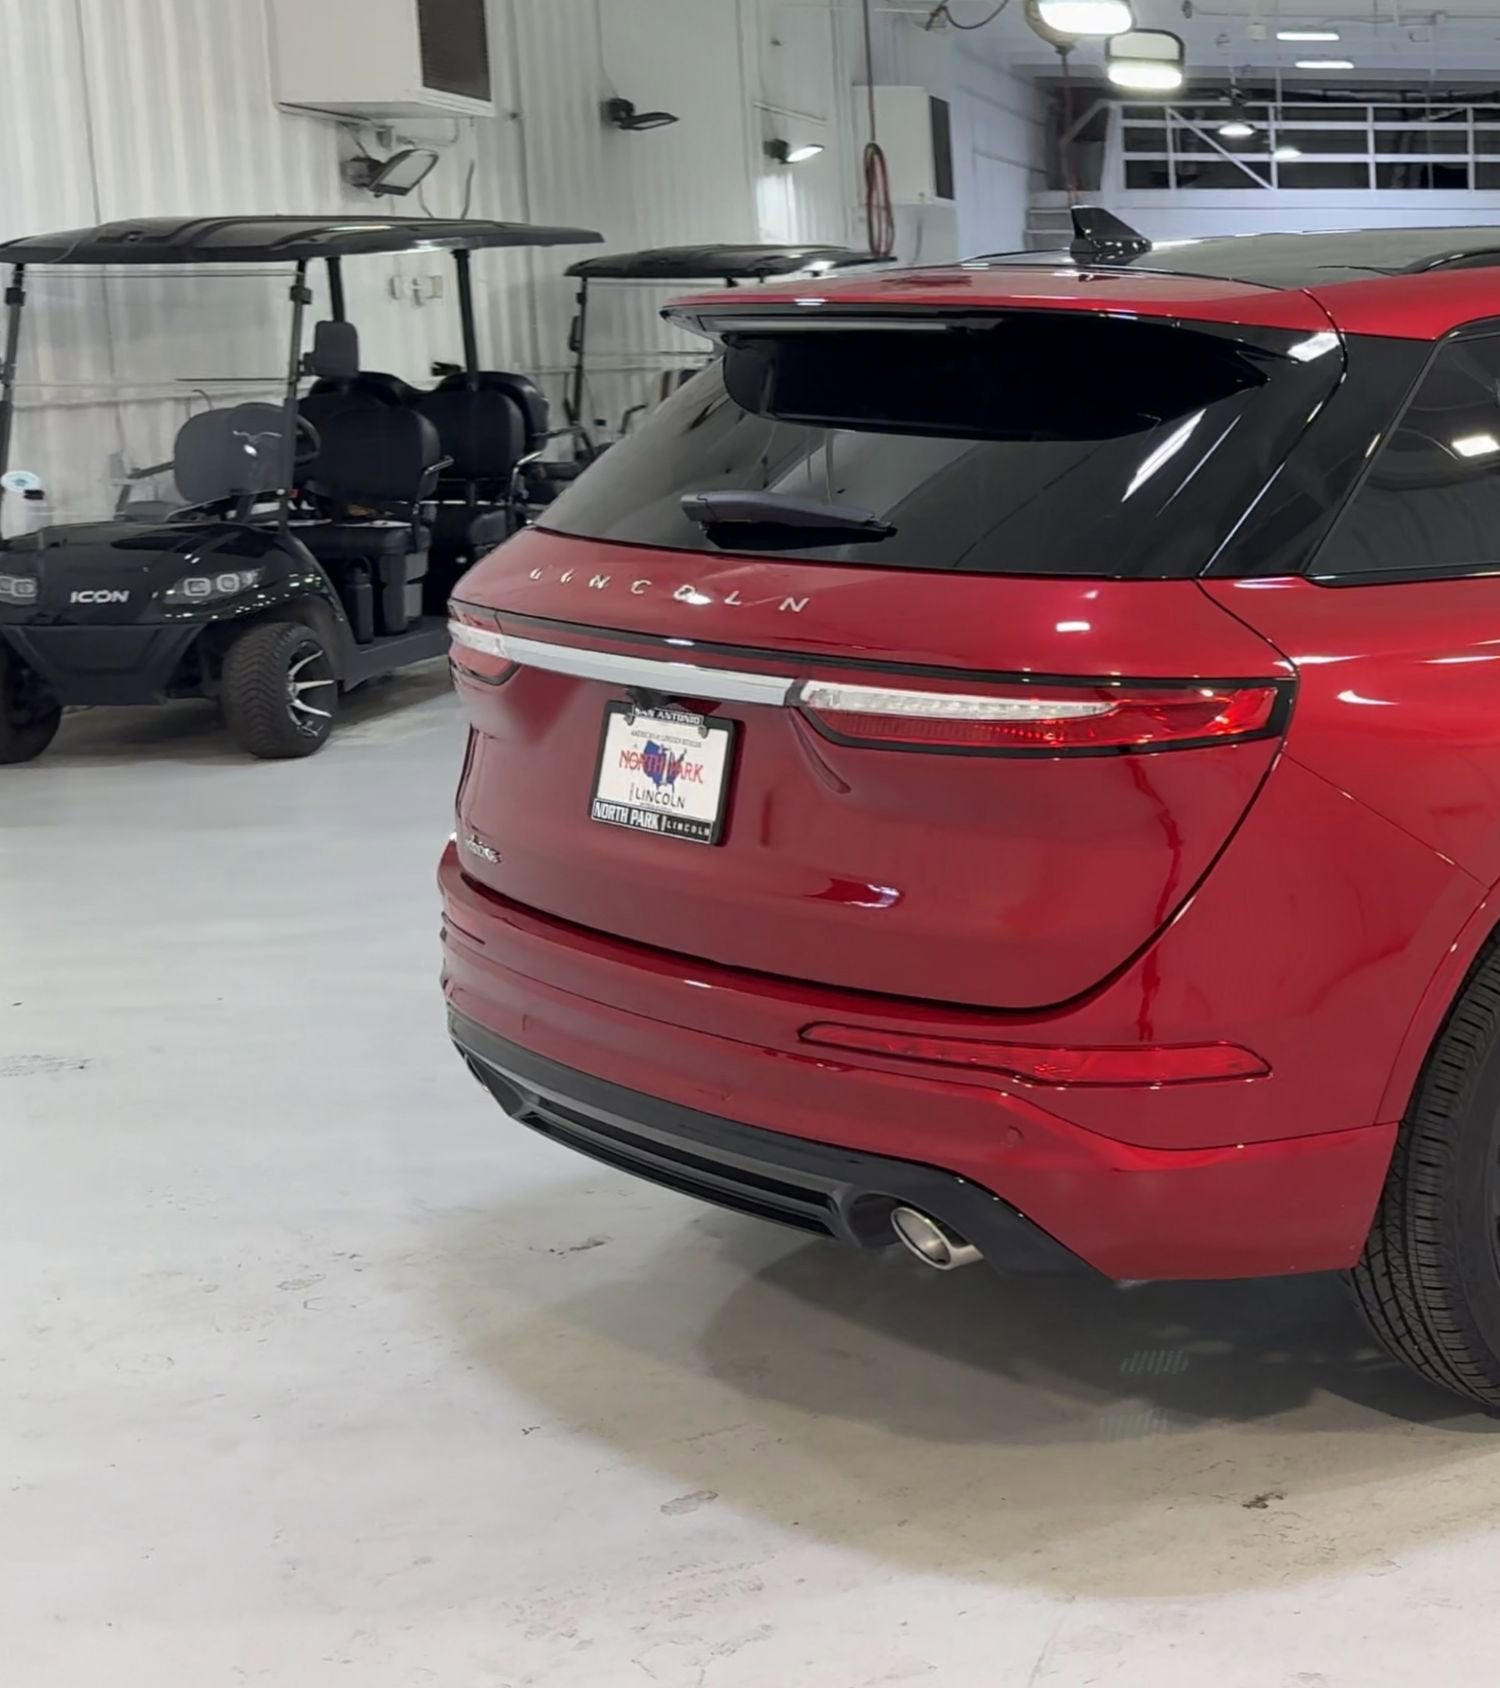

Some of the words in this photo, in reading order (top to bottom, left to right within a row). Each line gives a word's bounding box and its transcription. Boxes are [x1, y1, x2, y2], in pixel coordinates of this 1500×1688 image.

[70, 590, 130, 603] ICON
[635, 787, 686, 809] LINCOLN
[594, 802, 629, 823] NORTH
[630, 808, 660, 830] PARK
[667, 819, 711, 836] LINCOLN
